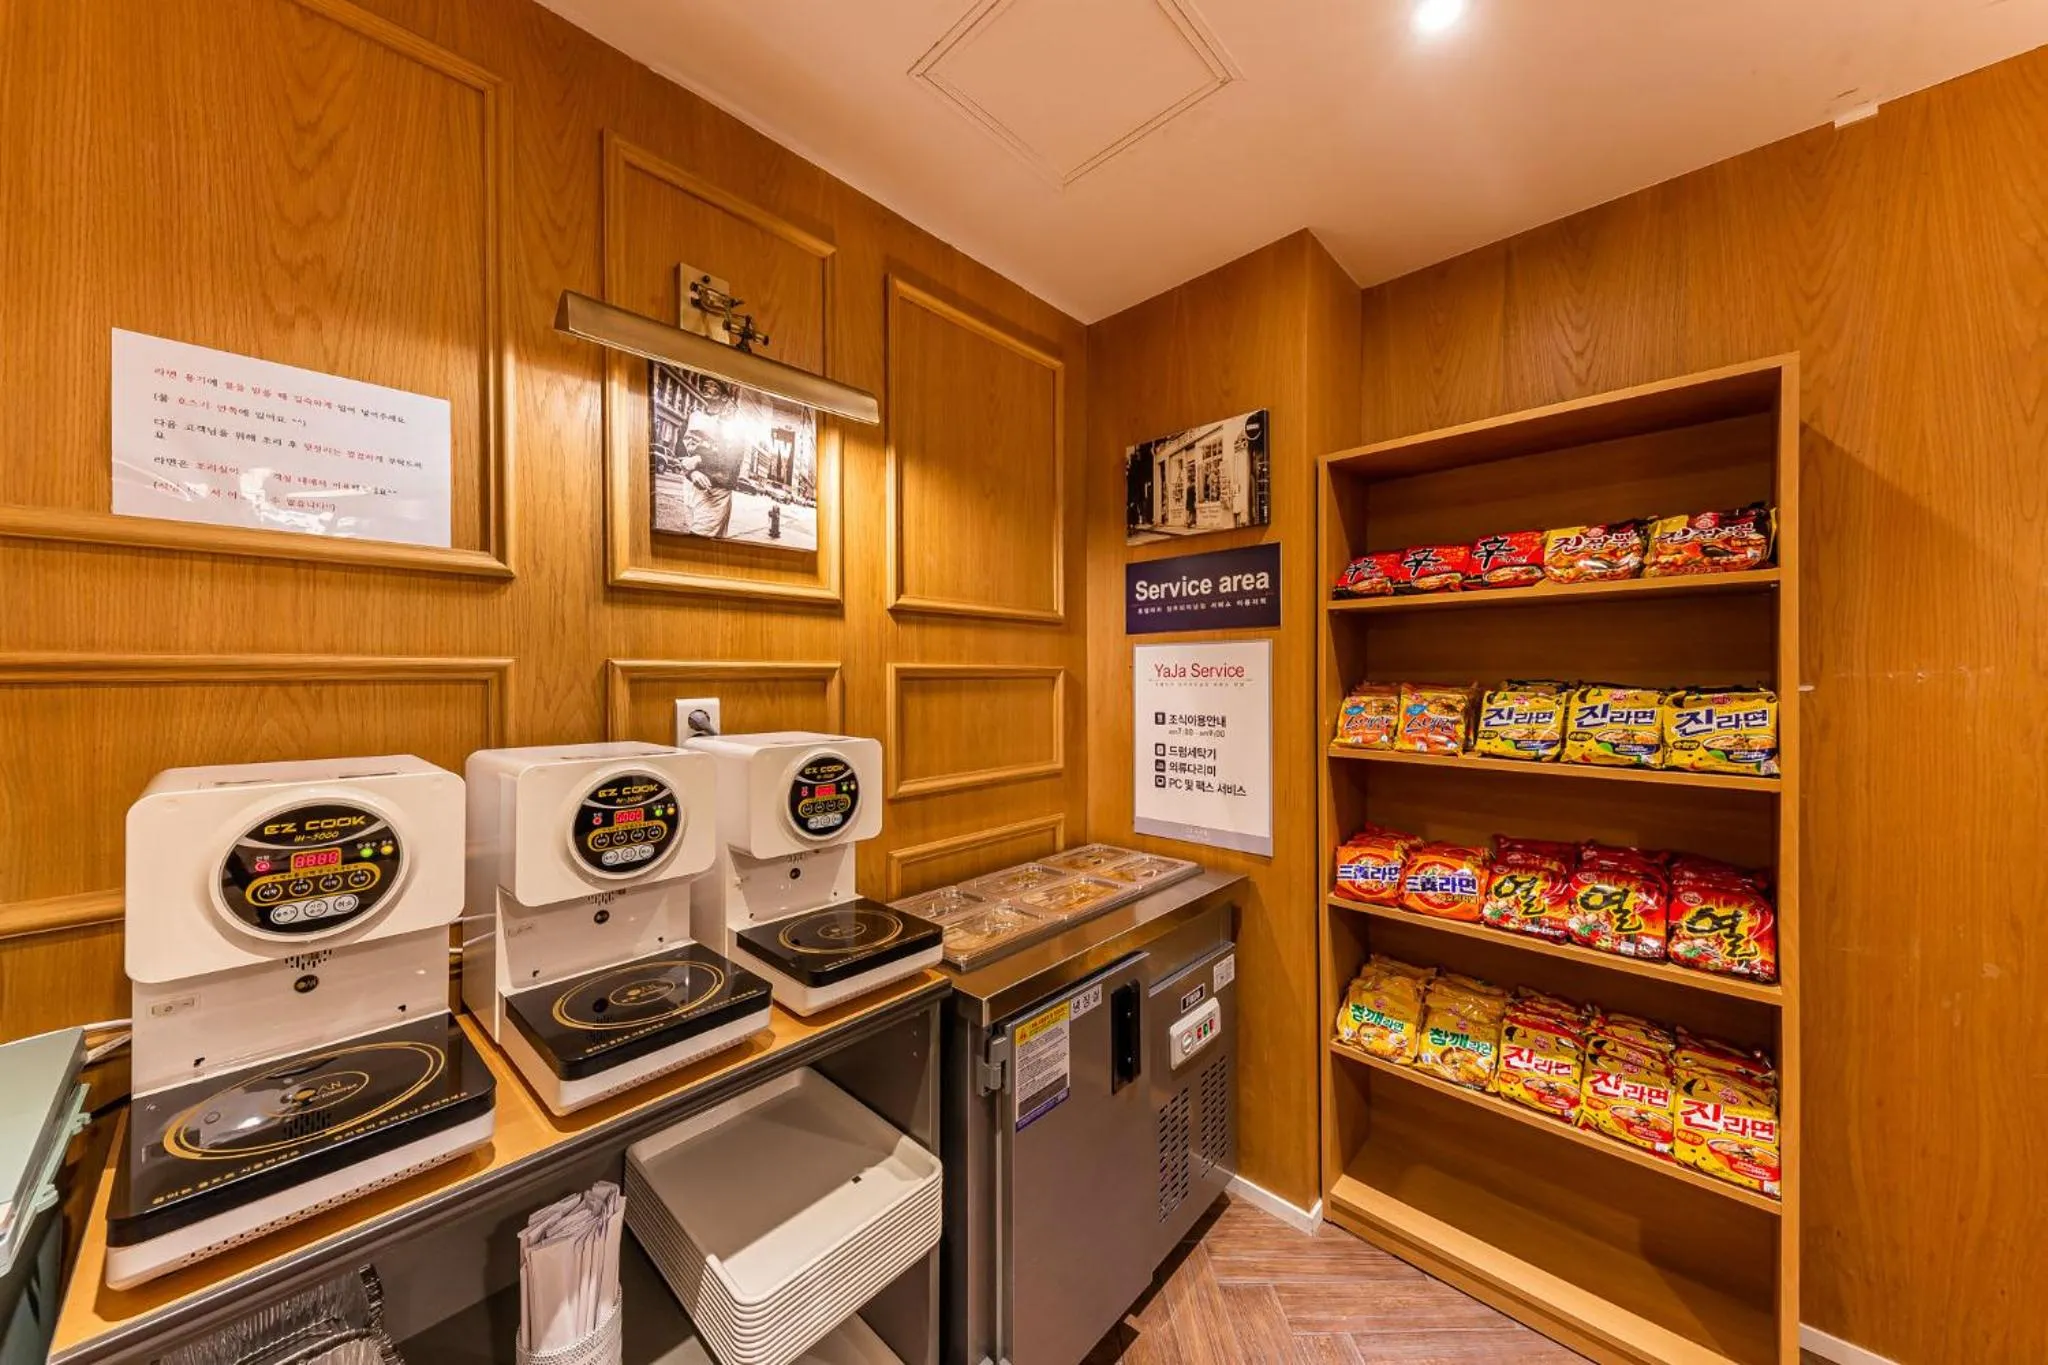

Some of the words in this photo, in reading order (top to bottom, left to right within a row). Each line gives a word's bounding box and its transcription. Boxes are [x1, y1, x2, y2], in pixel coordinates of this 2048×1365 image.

[1472, 535, 1516, 570] 辛
[1135, 576, 1213, 601] Service
[1219, 571, 1270, 594] area
[1154, 663, 1186, 678] YaJa
[1191, 662, 1245, 678] Service
[1168, 714, 1226, 729] 조식이용안내
[1484, 706, 1555, 728] 진라면
[1573, 703, 1657, 729] 진라면
[1674, 708, 1769, 737] 진라면
[1168, 745, 1217, 760] 드럼세탁기
[1168, 761, 1217, 777] 의류다리미
[598, 788, 618, 798] EZ
[622, 784, 659, 795] COOK
[1169, 777, 1183, 789] PC
[1217, 782, 1248, 797] 서비스
[264, 822, 297, 835] EZ
[305, 815, 367, 831] COOK
[1578, 883, 1643, 933] 열
[1683, 906, 1759, 959] 열
[1588, 1068, 1670, 1108] 진라면
[1679, 1098, 1776, 1142] 진라면
